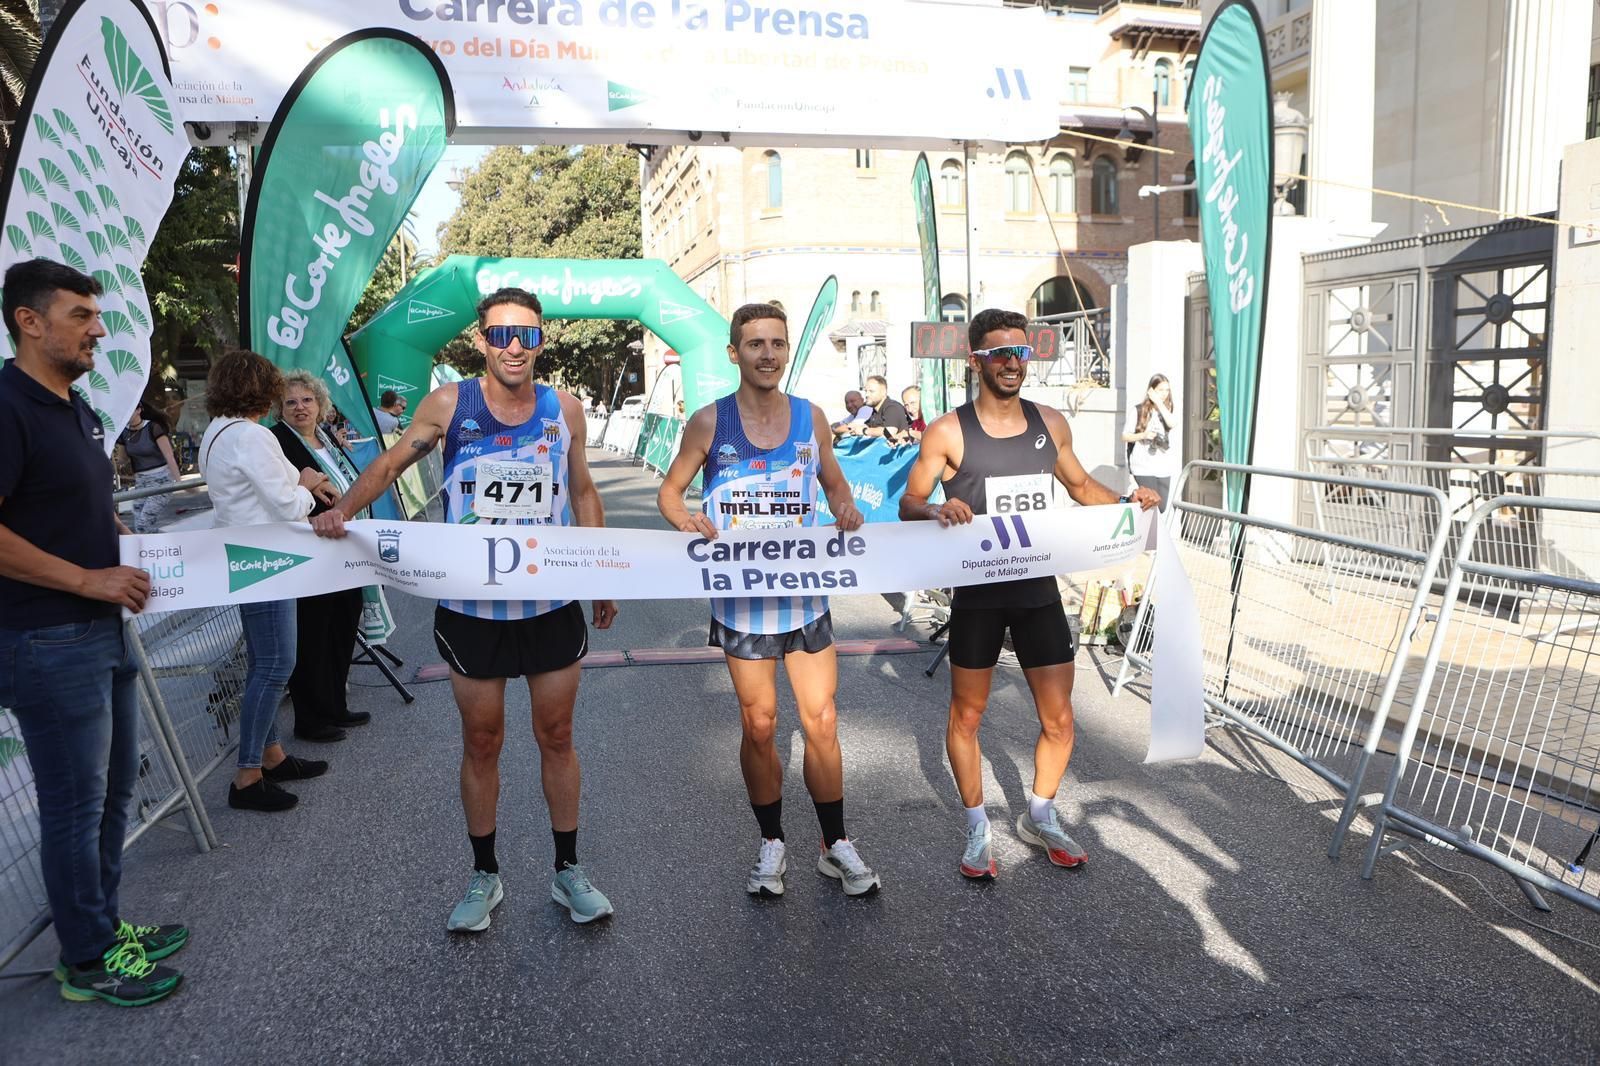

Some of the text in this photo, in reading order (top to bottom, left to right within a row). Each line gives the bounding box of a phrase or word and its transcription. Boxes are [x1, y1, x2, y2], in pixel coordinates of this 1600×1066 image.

[400, 0, 869, 39] Carrera de la Prensa
[463, 37, 502, 57] del
[510, 38, 550, 59] Día
[172, 80, 215, 91] ociación
[81, 53, 164, 171] Fundación
[86, 91, 138, 178] Unicaja
[313, 104, 417, 237] Inglés
[285, 222, 351, 311] Corte
[561, 267, 642, 305] Inglés
[267, 306, 309, 350] El
[484, 481, 542, 503] 471
[732, 490, 801, 498] ATLETISMO
[995, 492, 1047, 514] 668
[139, 545, 182, 560] ospital
[544, 545, 620, 556] Asociación de la
[687, 530, 866, 562] Carrera de
[230, 555, 294, 572] El Corte Inglés
[544, 558, 631, 569] Prensa de Málaga
[962, 551, 1051, 570] Diputación Provincial
[413, 568, 447, 579] Málaga
[701, 567, 859, 591] la Prensa
[984, 566, 1029, 579] de Málaga
[150, 585, 184, 599] álaga
